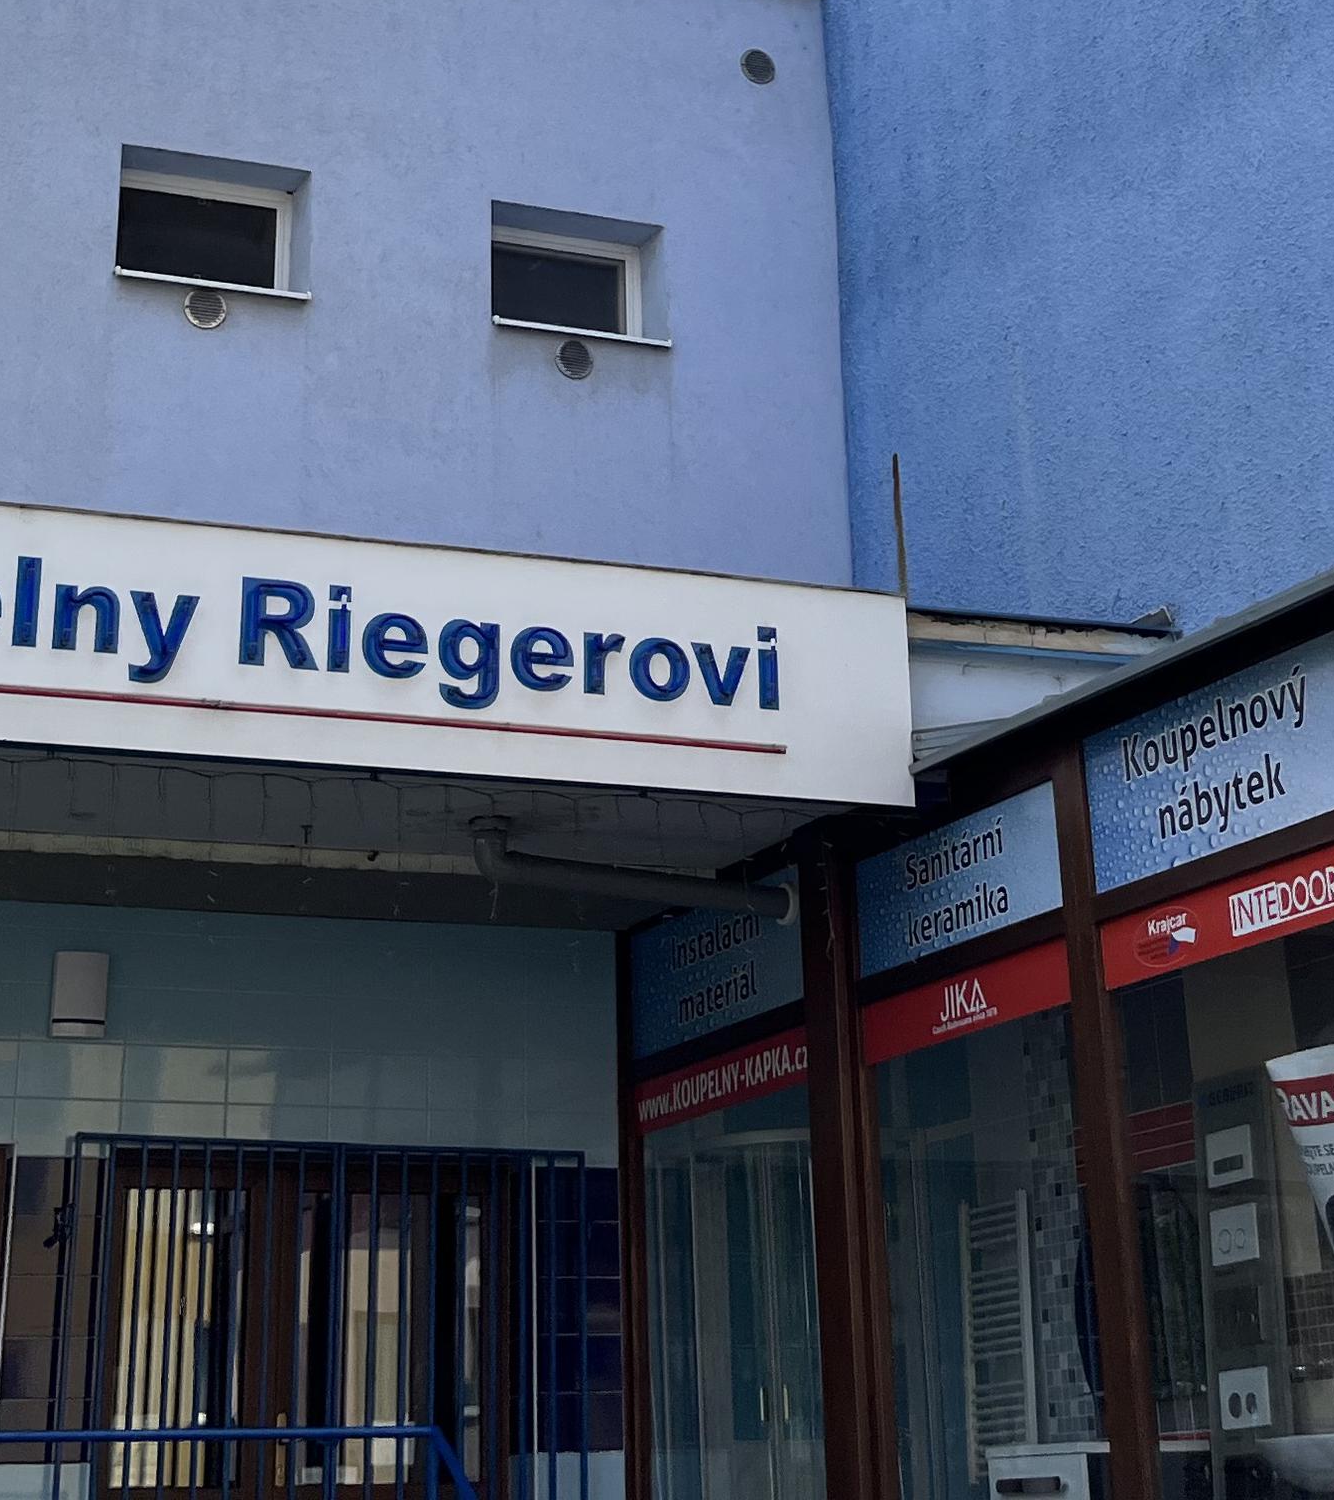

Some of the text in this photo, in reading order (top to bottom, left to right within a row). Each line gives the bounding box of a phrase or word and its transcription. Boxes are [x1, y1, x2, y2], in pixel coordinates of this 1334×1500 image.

[239, 576, 781, 710] Riegerovi
[1122, 667, 1308, 784] Koupelnový
[1158, 753, 1286, 841] nábytek
[905, 815, 1005, 891] Sanitární
[907, 883, 1009, 947] keramika
[1147, 912, 1187, 935] Krajcar
[679, 960, 758, 1024] materiál
[940, 978, 987, 1021] JIKA
